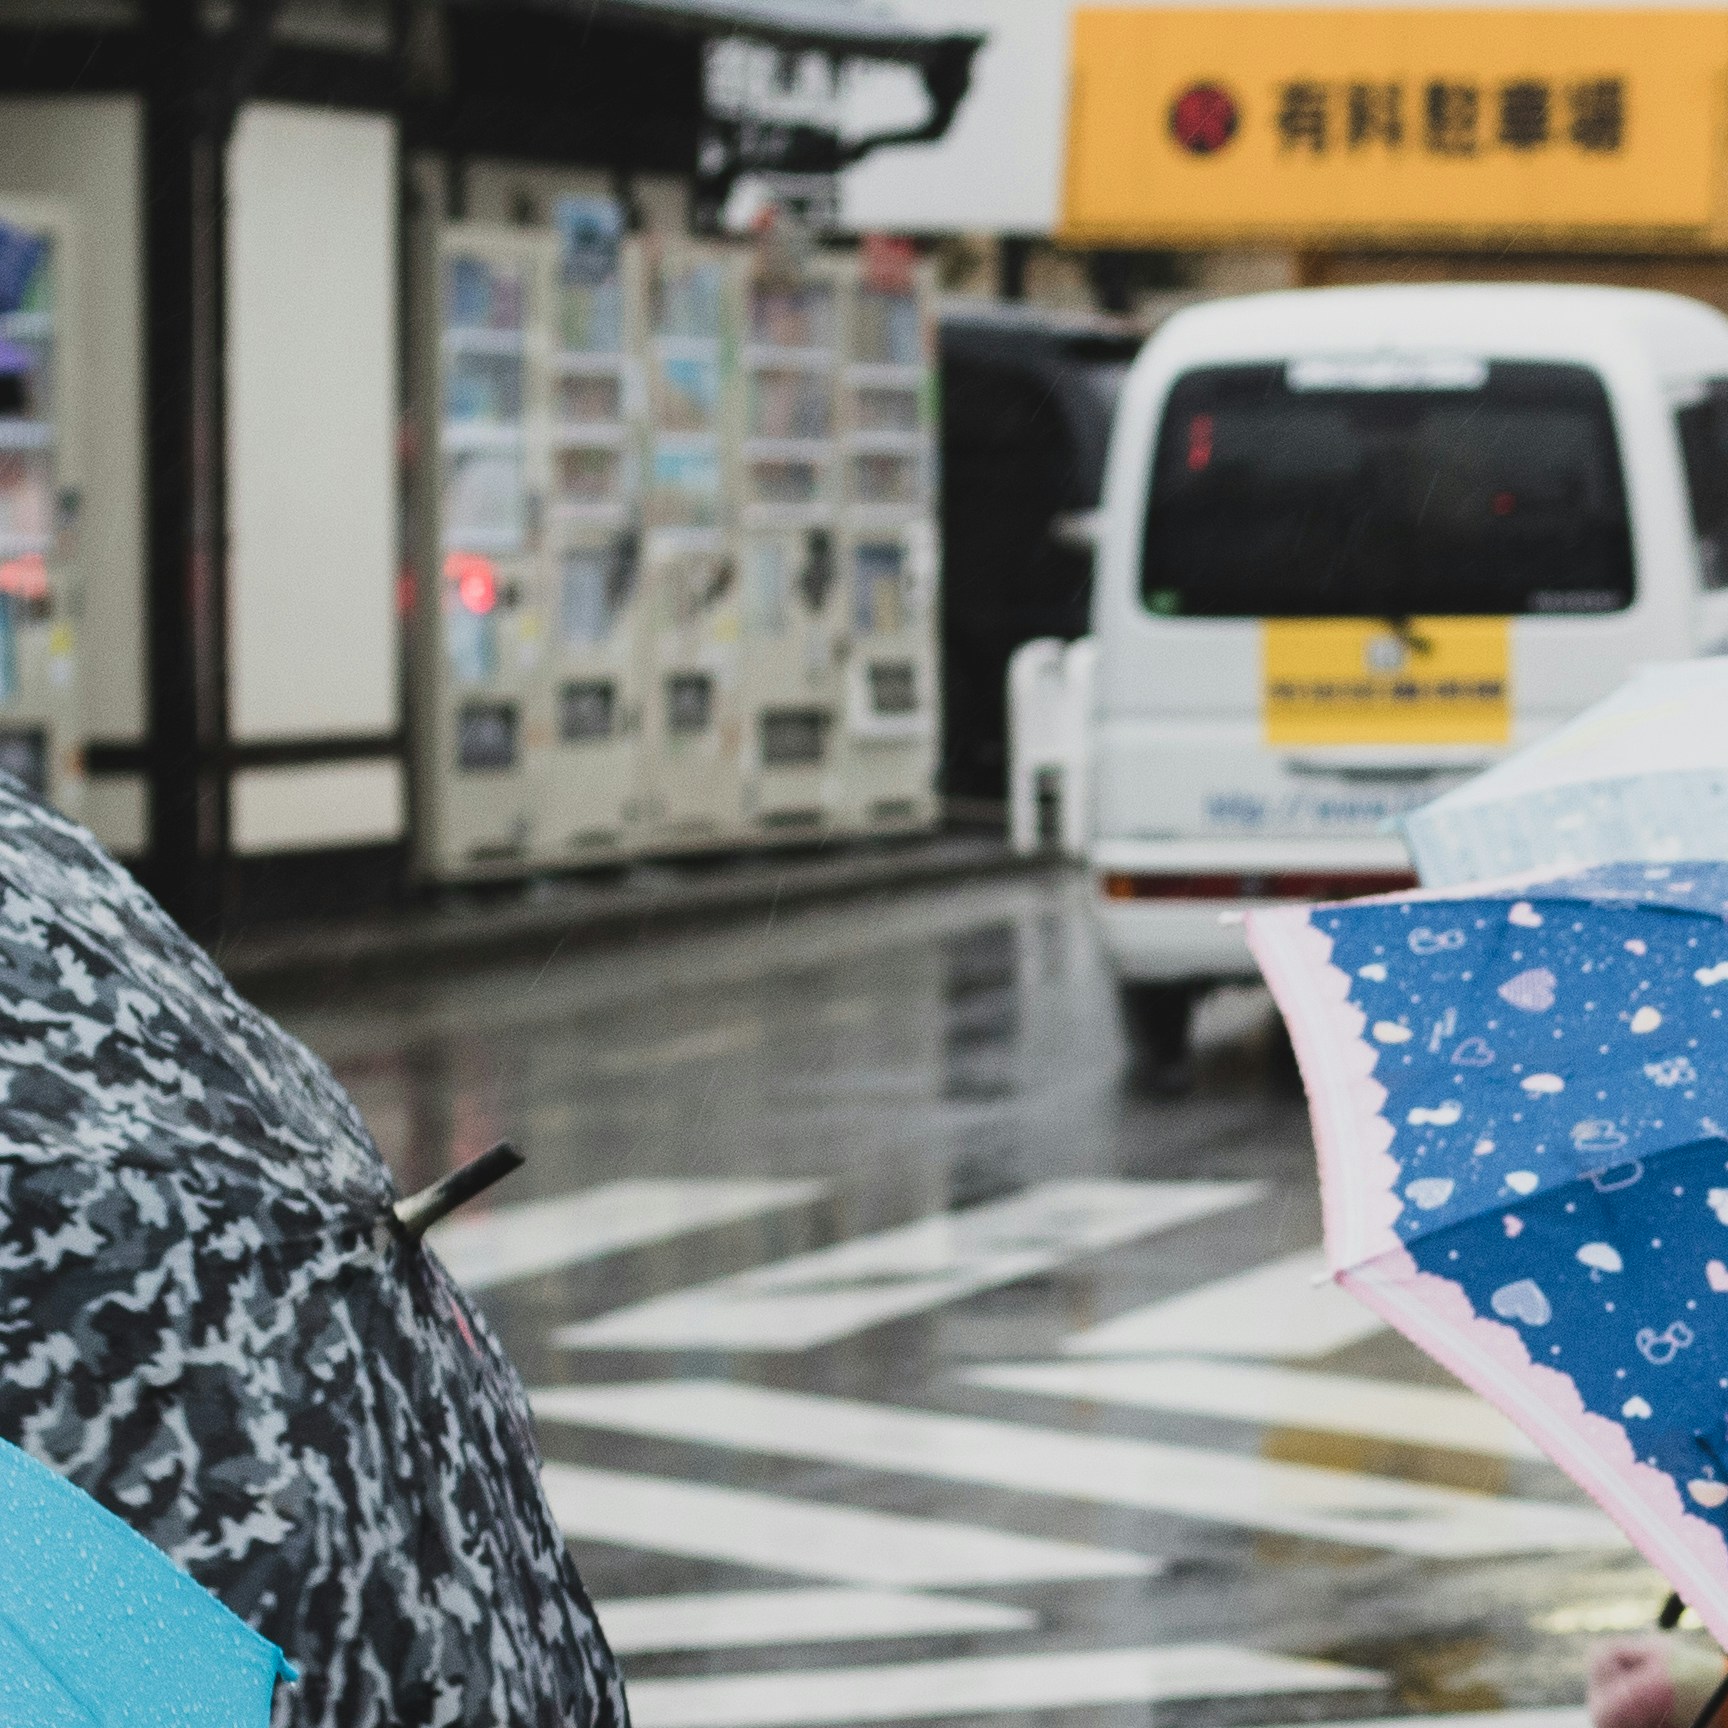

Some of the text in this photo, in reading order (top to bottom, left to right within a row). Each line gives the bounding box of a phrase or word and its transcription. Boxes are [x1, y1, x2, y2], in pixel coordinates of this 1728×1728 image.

[1275, 76, 1626, 157] 有料駐車場
